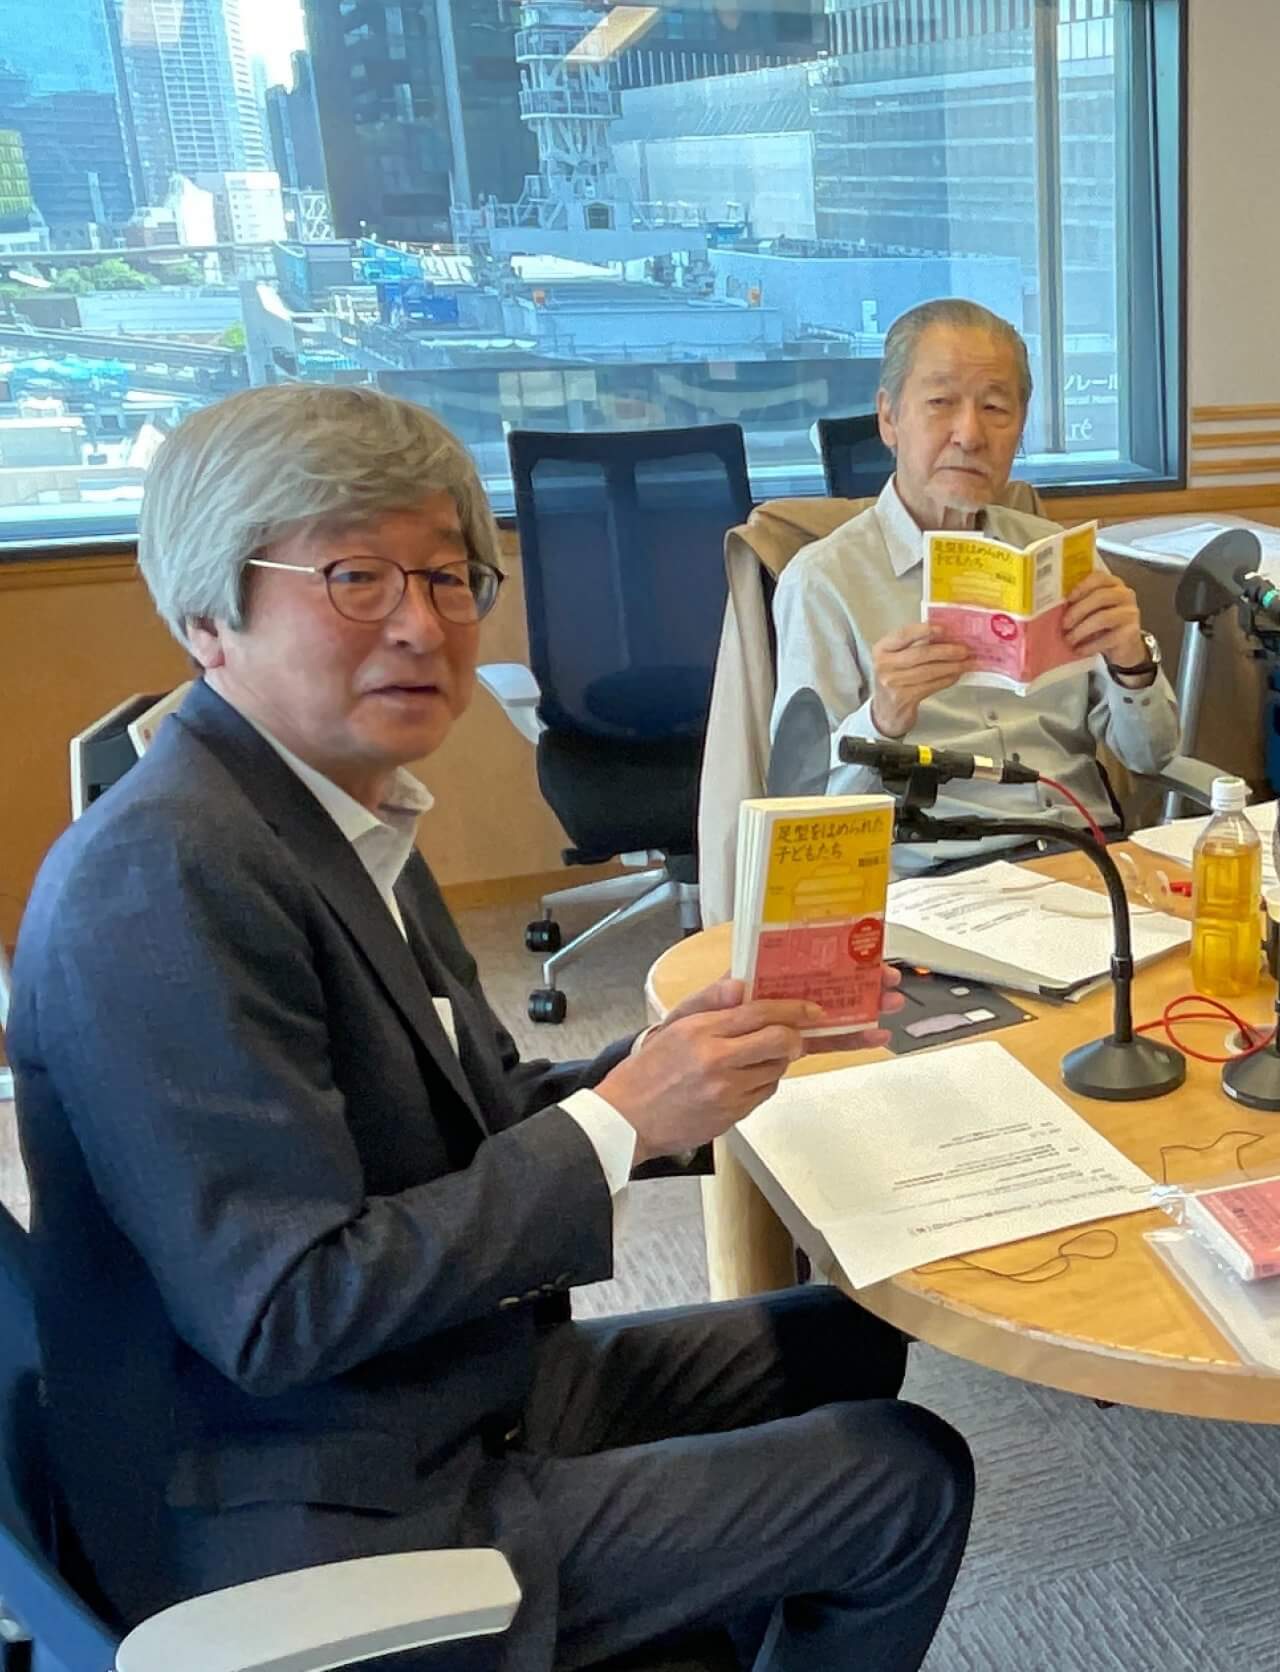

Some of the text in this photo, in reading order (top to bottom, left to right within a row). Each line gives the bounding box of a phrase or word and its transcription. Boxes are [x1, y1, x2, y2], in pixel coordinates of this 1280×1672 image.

[774, 843, 843, 864] 子どもたち
